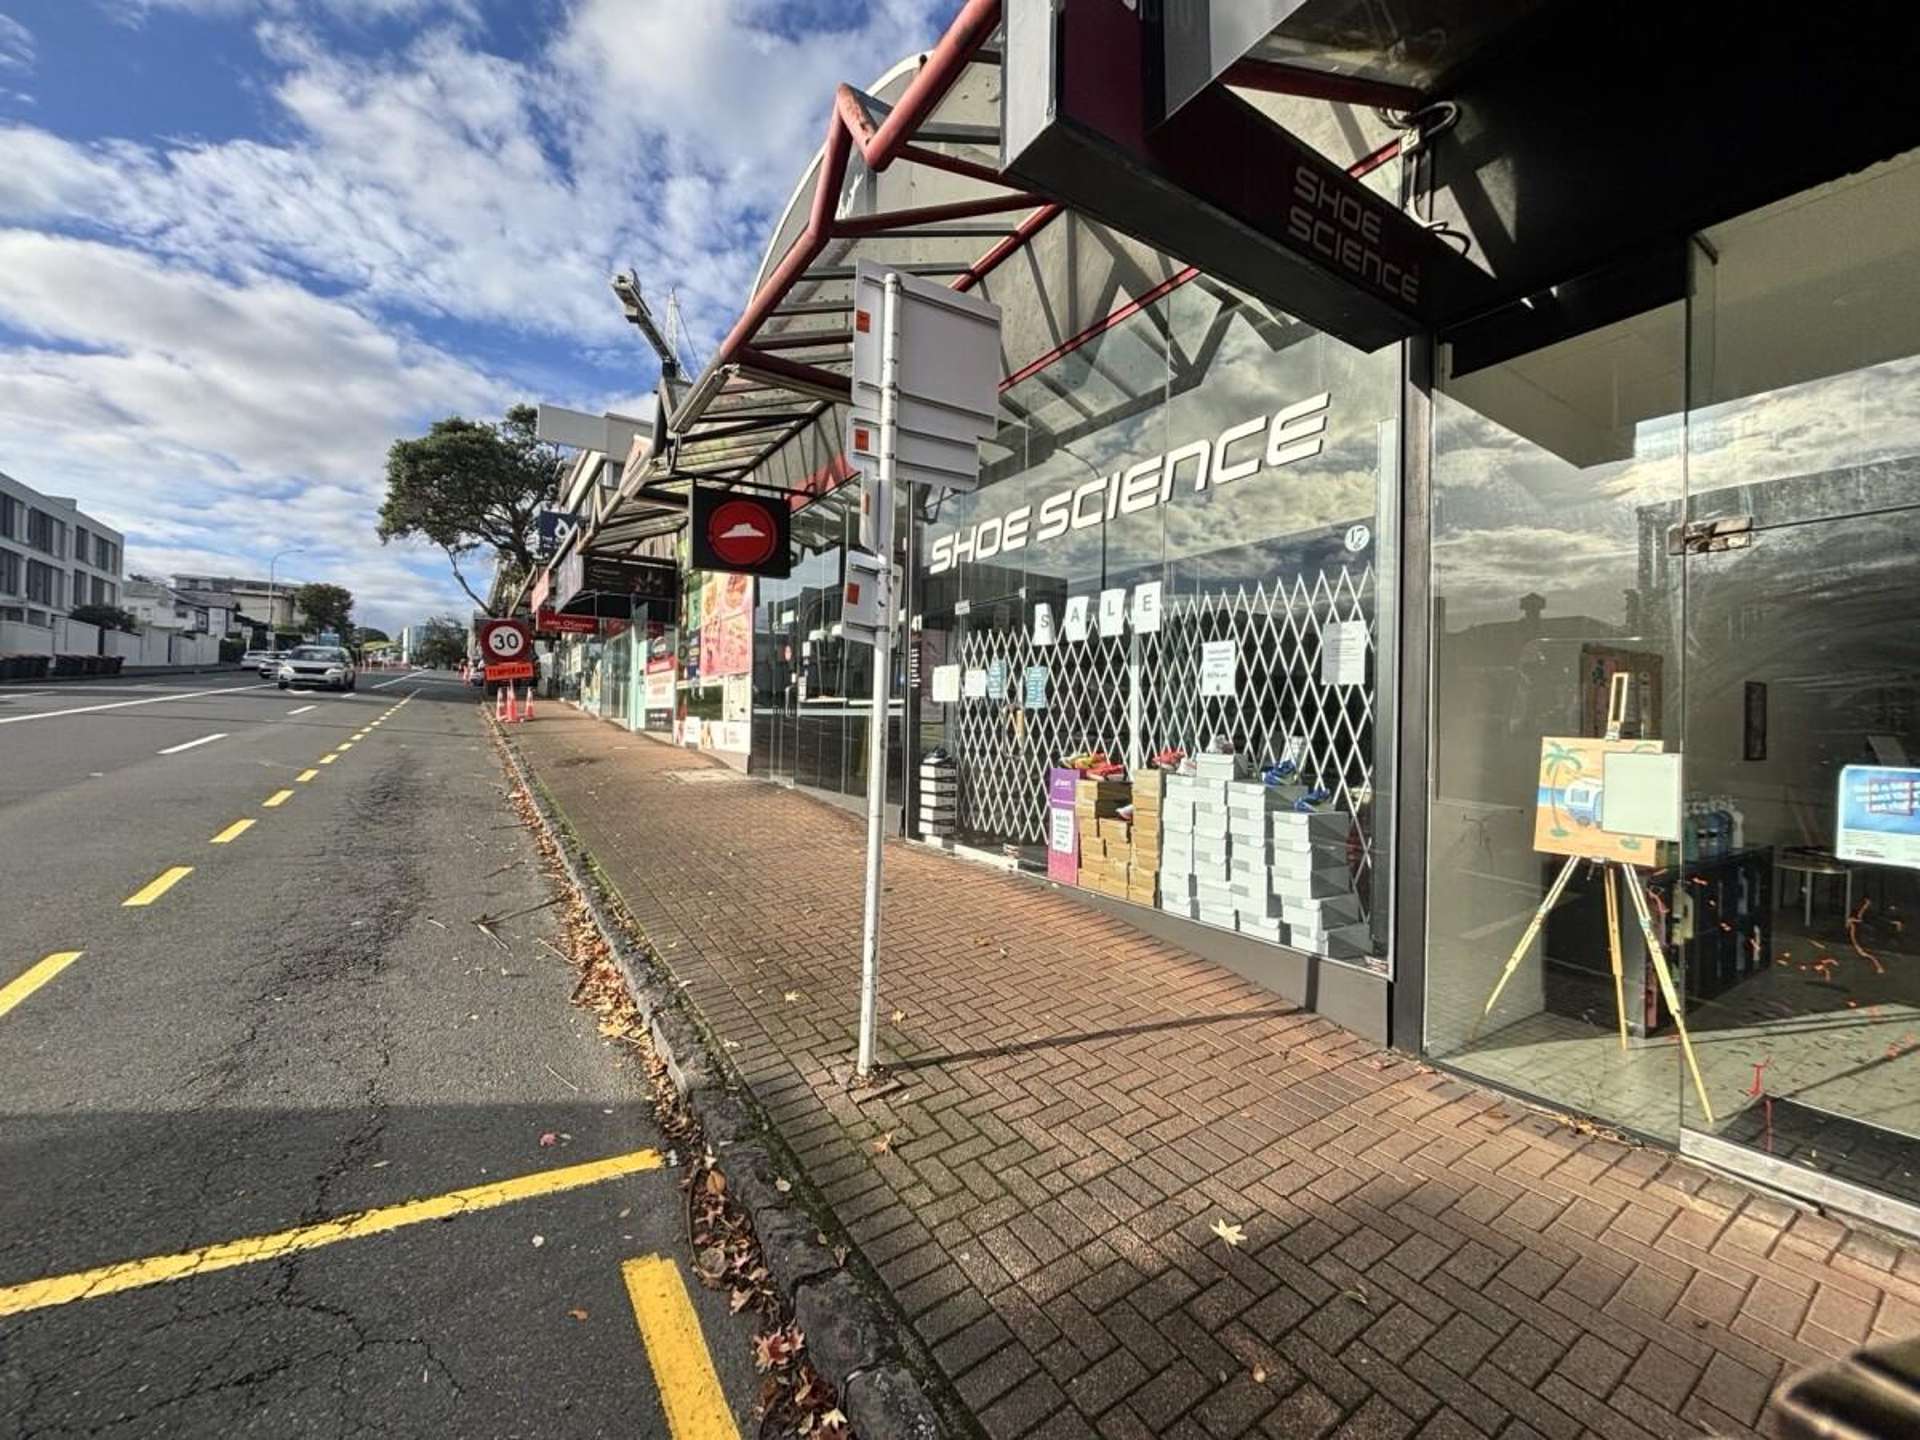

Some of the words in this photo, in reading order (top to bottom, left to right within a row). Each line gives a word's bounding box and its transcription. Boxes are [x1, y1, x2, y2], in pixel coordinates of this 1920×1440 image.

[1294, 166, 1382, 243] SHOE
[1288, 205, 1419, 304] SCIENCE
[929, 505, 1033, 575] SHOE
[1036, 391, 1331, 542] SCIENCE
[494, 633, 519, 650] 30
